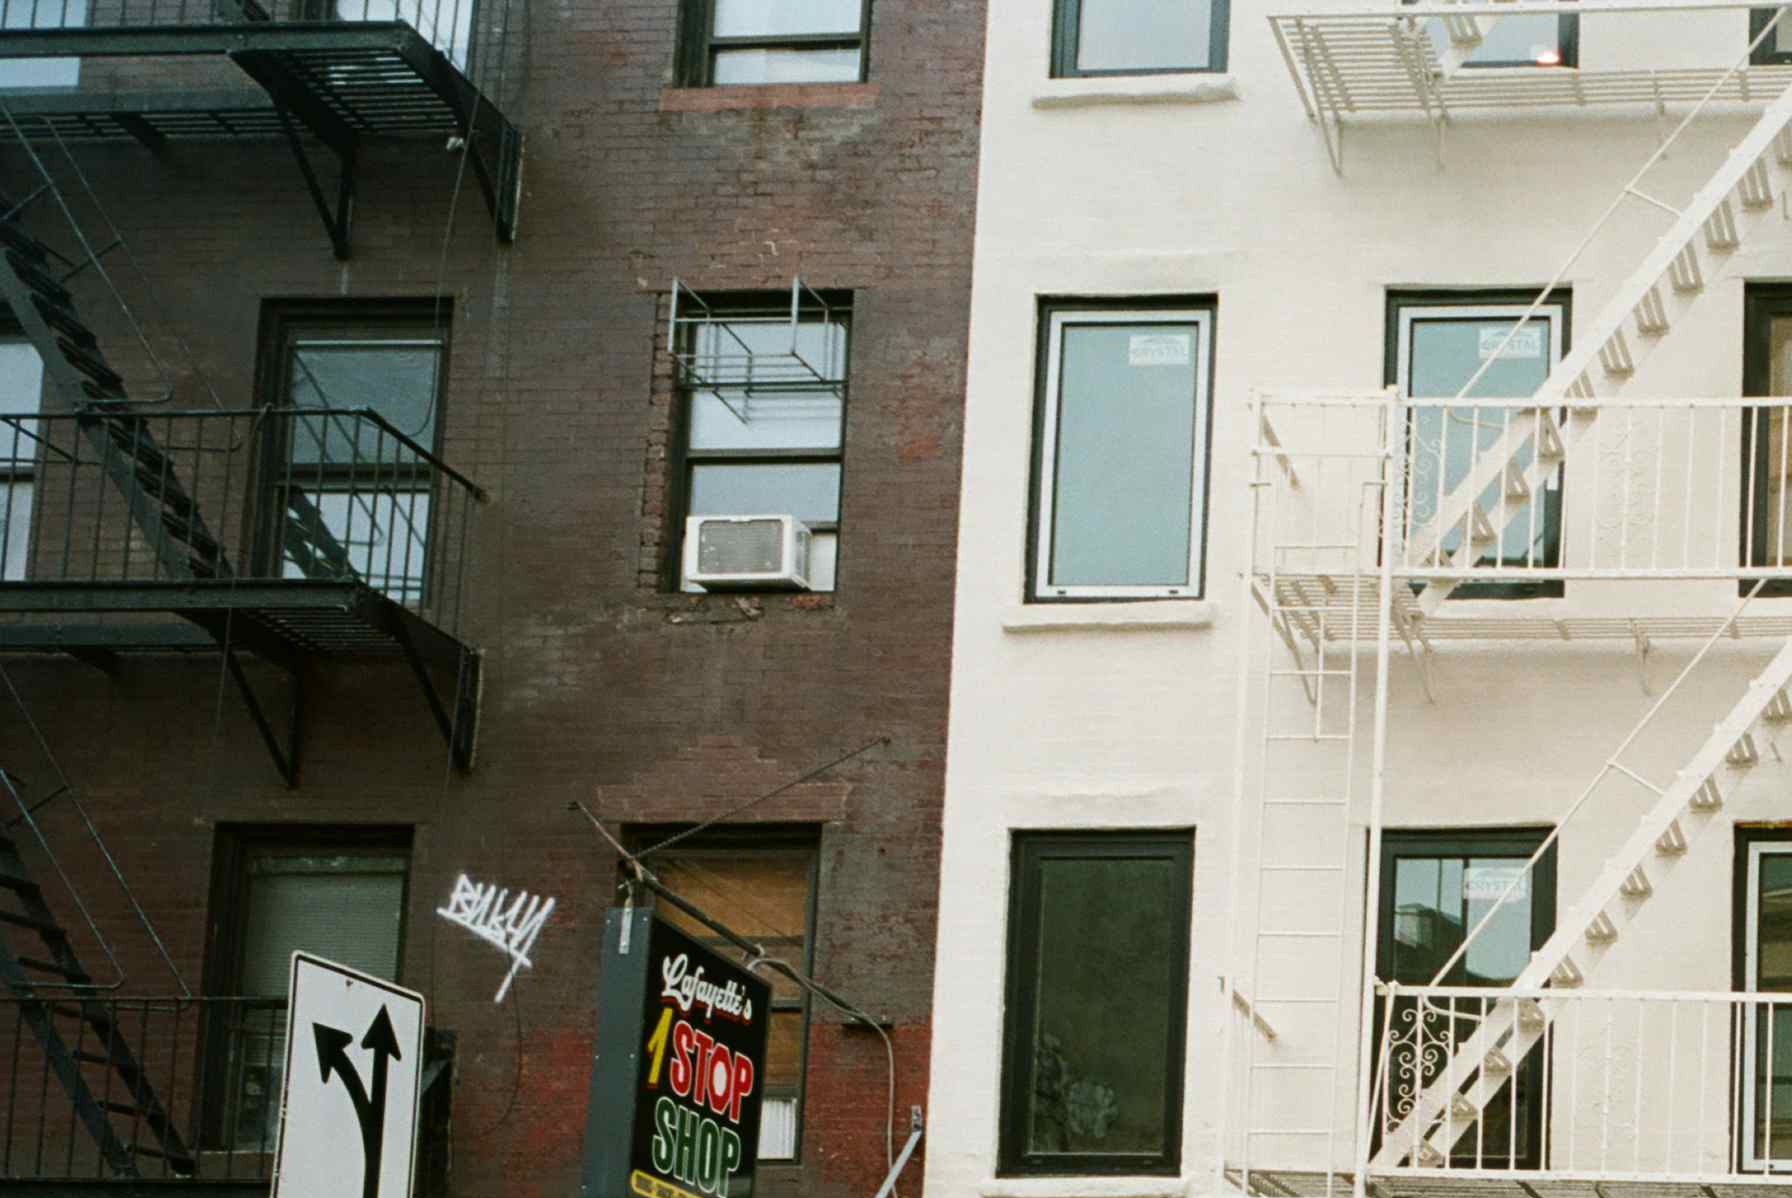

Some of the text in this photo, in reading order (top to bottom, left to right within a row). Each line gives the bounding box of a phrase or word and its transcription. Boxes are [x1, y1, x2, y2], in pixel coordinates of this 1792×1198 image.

[661, 953, 752, 1021] Lafayette's
[647, 1006, 753, 1123] 1 STOP
